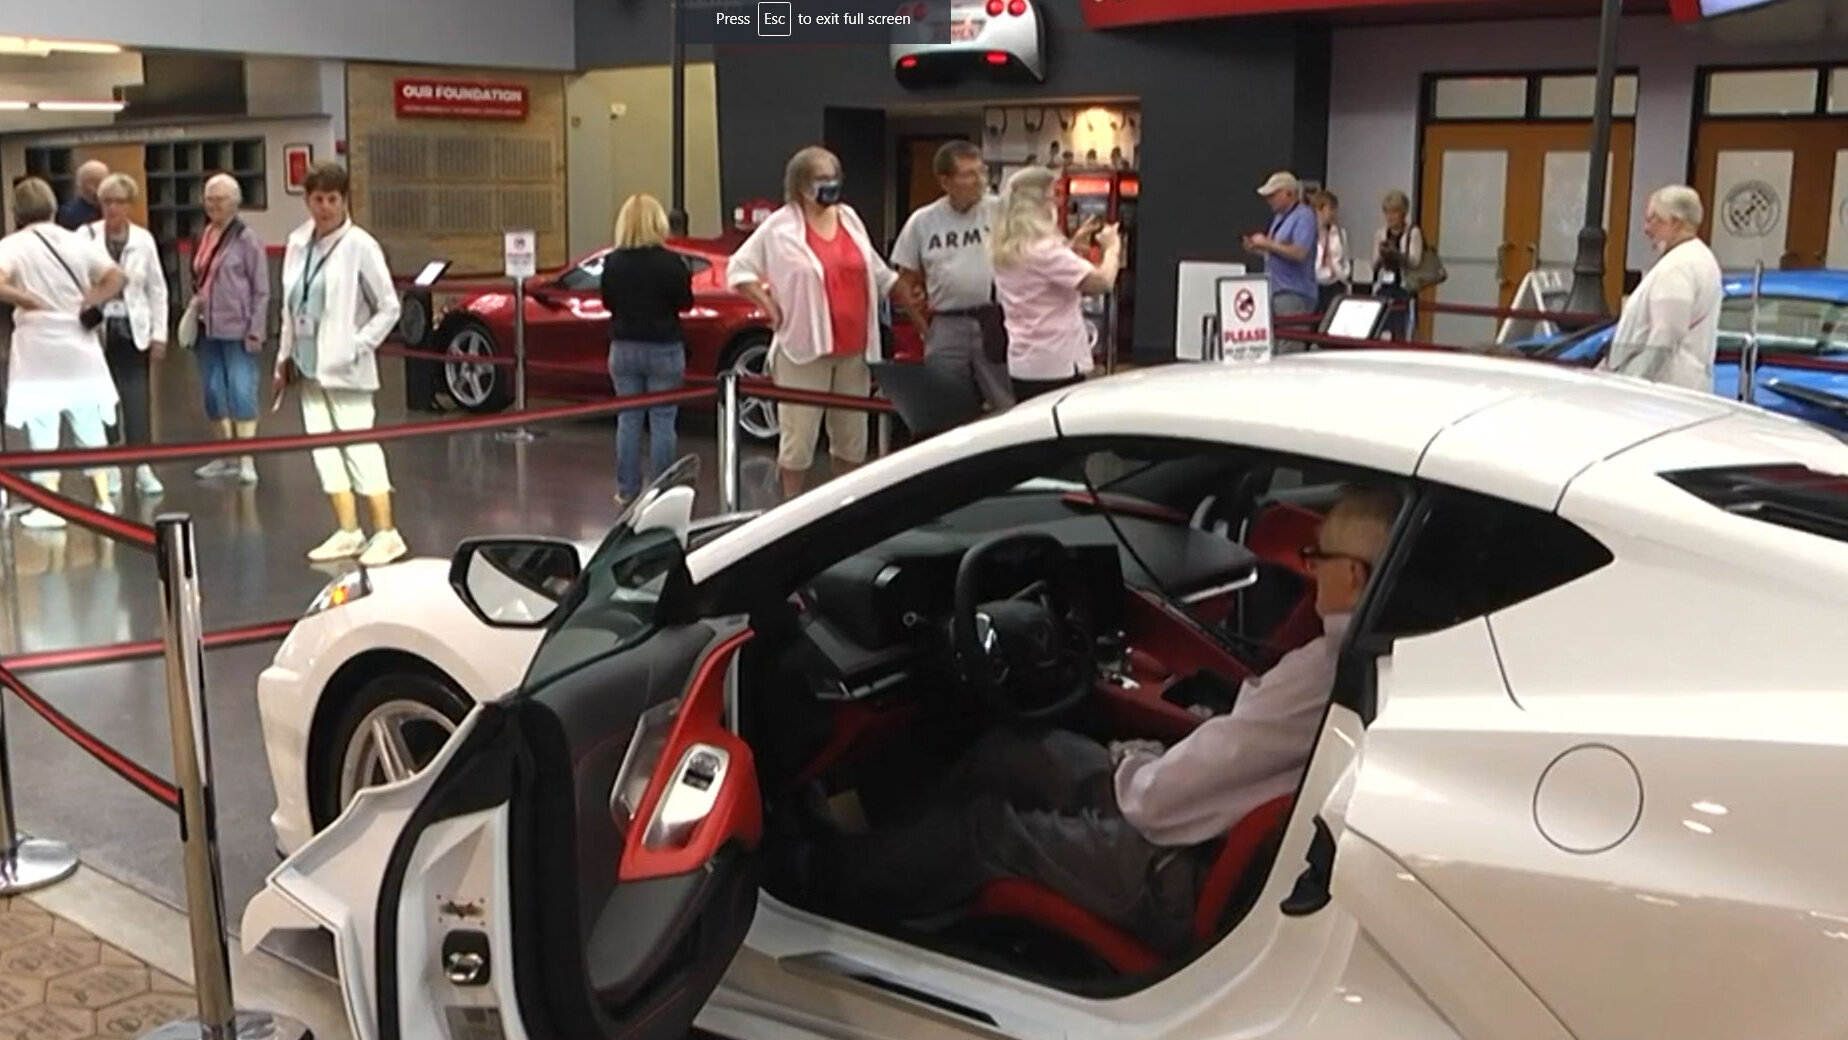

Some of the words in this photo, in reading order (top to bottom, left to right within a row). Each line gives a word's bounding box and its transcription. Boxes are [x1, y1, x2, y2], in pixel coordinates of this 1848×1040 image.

[402, 85, 433, 98] OUR
[435, 86, 522, 101] FOUNDATION
[928, 225, 990, 250] ARM
[1224, 328, 1267, 343] PLEASE
